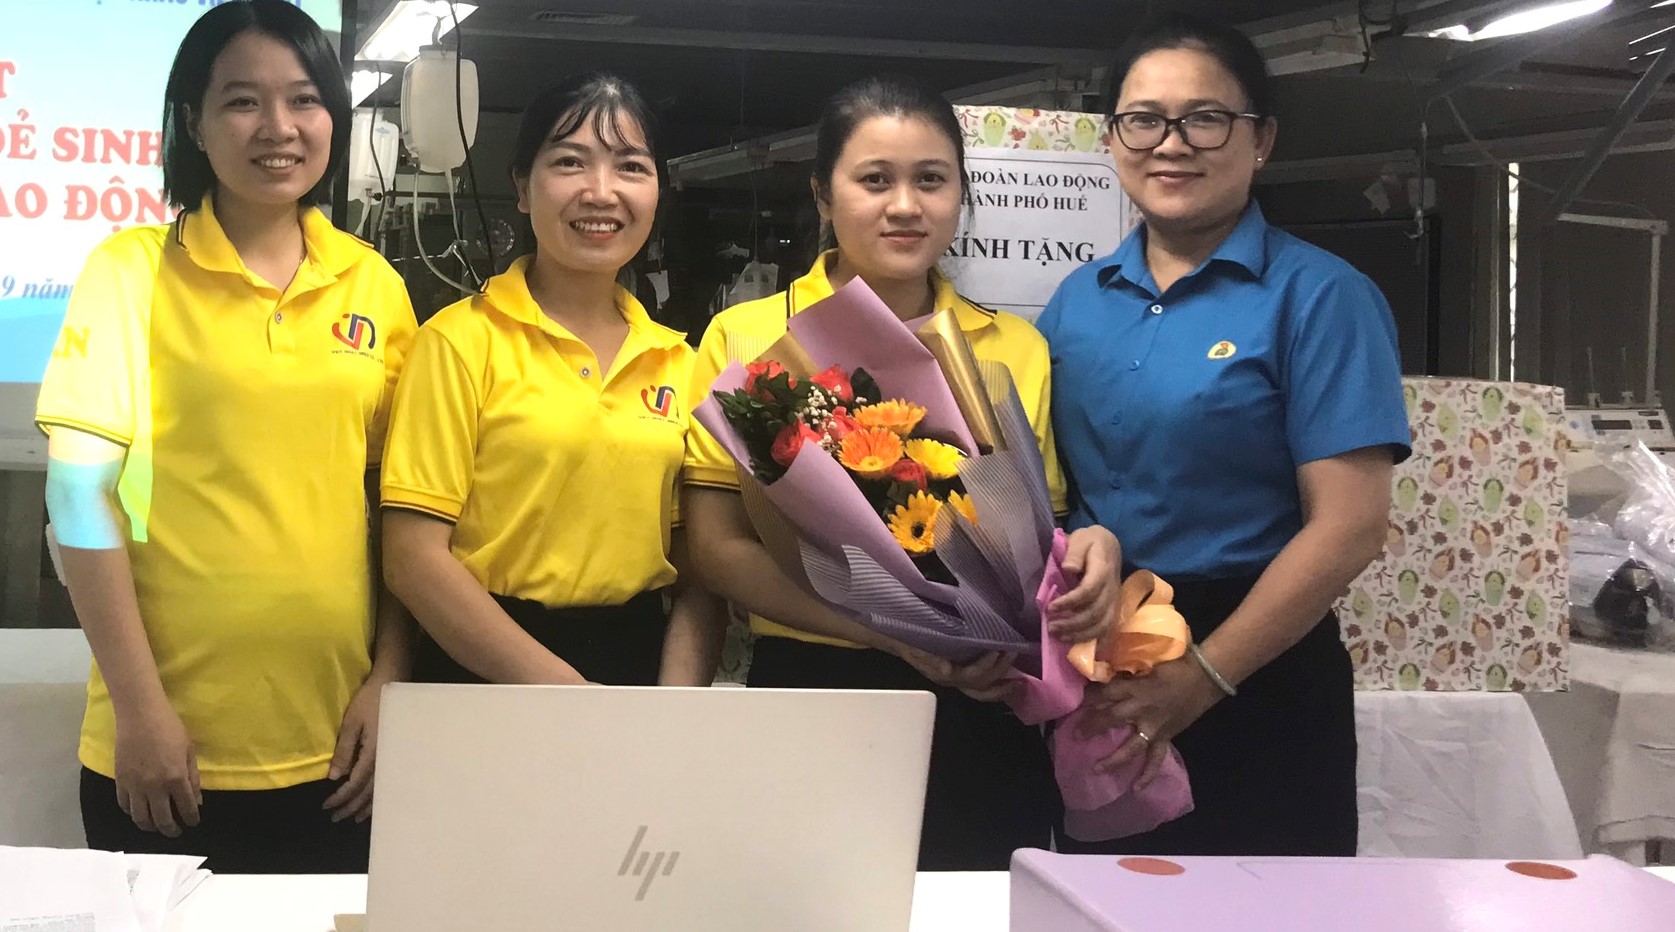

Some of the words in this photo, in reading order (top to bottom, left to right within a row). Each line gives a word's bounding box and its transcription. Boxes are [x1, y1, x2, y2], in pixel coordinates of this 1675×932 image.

[0, 108, 37, 160] Ẻ
[52, 126, 164, 167] SINH
[970, 168, 1018, 185] ĐOÀN
[1023, 173, 1058, 187] LAO
[1063, 173, 1110, 191] ĐỘNG
[63, 175, 181, 233] ĐỘN
[1014, 193, 1048, 209] PHỐ
[1053, 195, 1087, 211] HUẾ
[1018, 237, 1095, 266] TẶNG
[1, 275, 16, 298] 9
